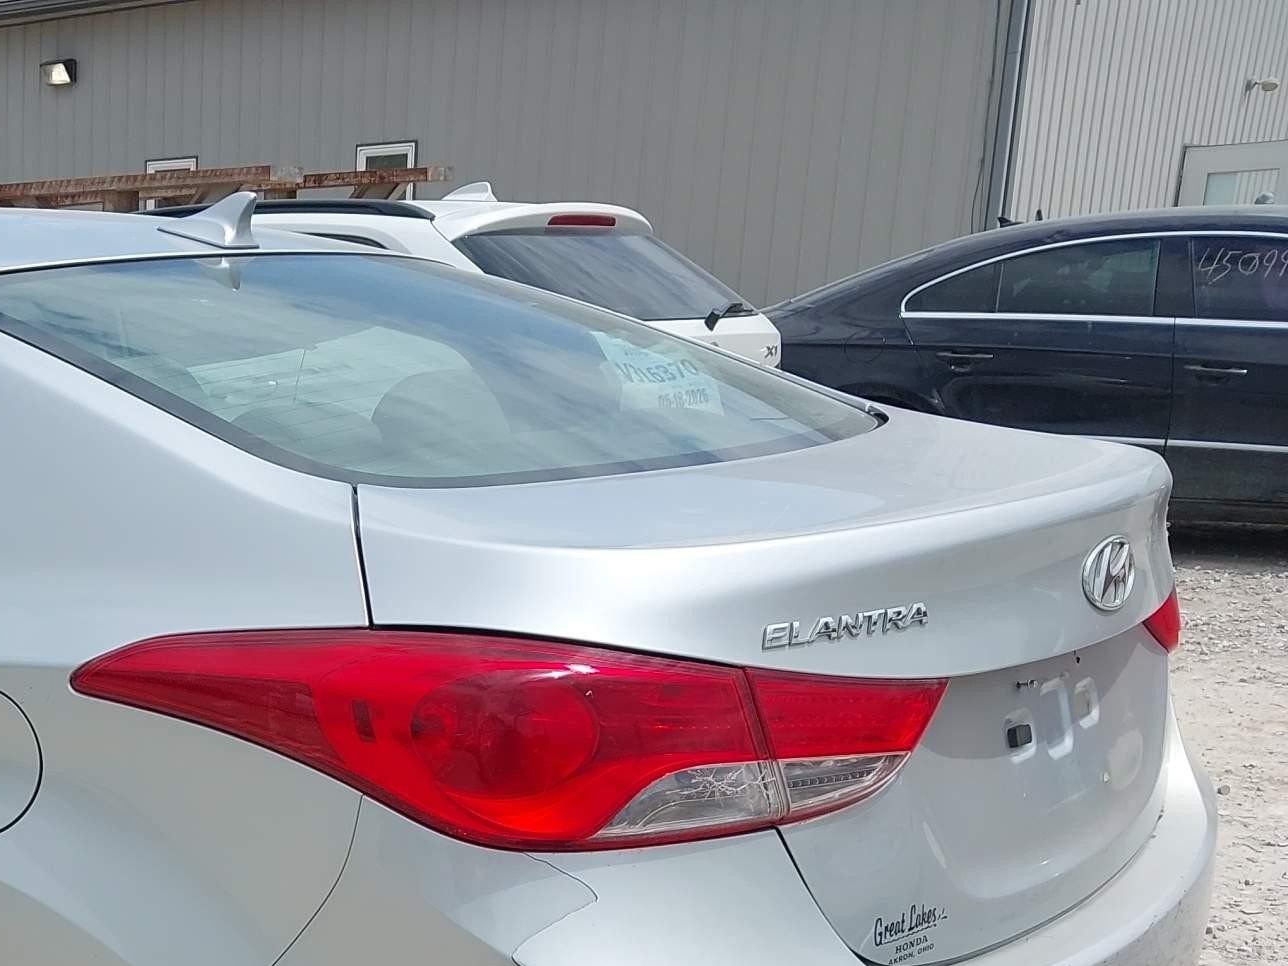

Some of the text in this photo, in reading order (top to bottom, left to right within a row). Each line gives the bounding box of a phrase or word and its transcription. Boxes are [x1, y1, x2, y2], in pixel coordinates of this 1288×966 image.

[764, 344, 778, 359] X1
[762, 602, 929, 650] ELANTRA
[874, 904, 937, 947] Great Lakes
[895, 935, 928, 954] HONDA
[917, 943, 935, 955] OHIO
